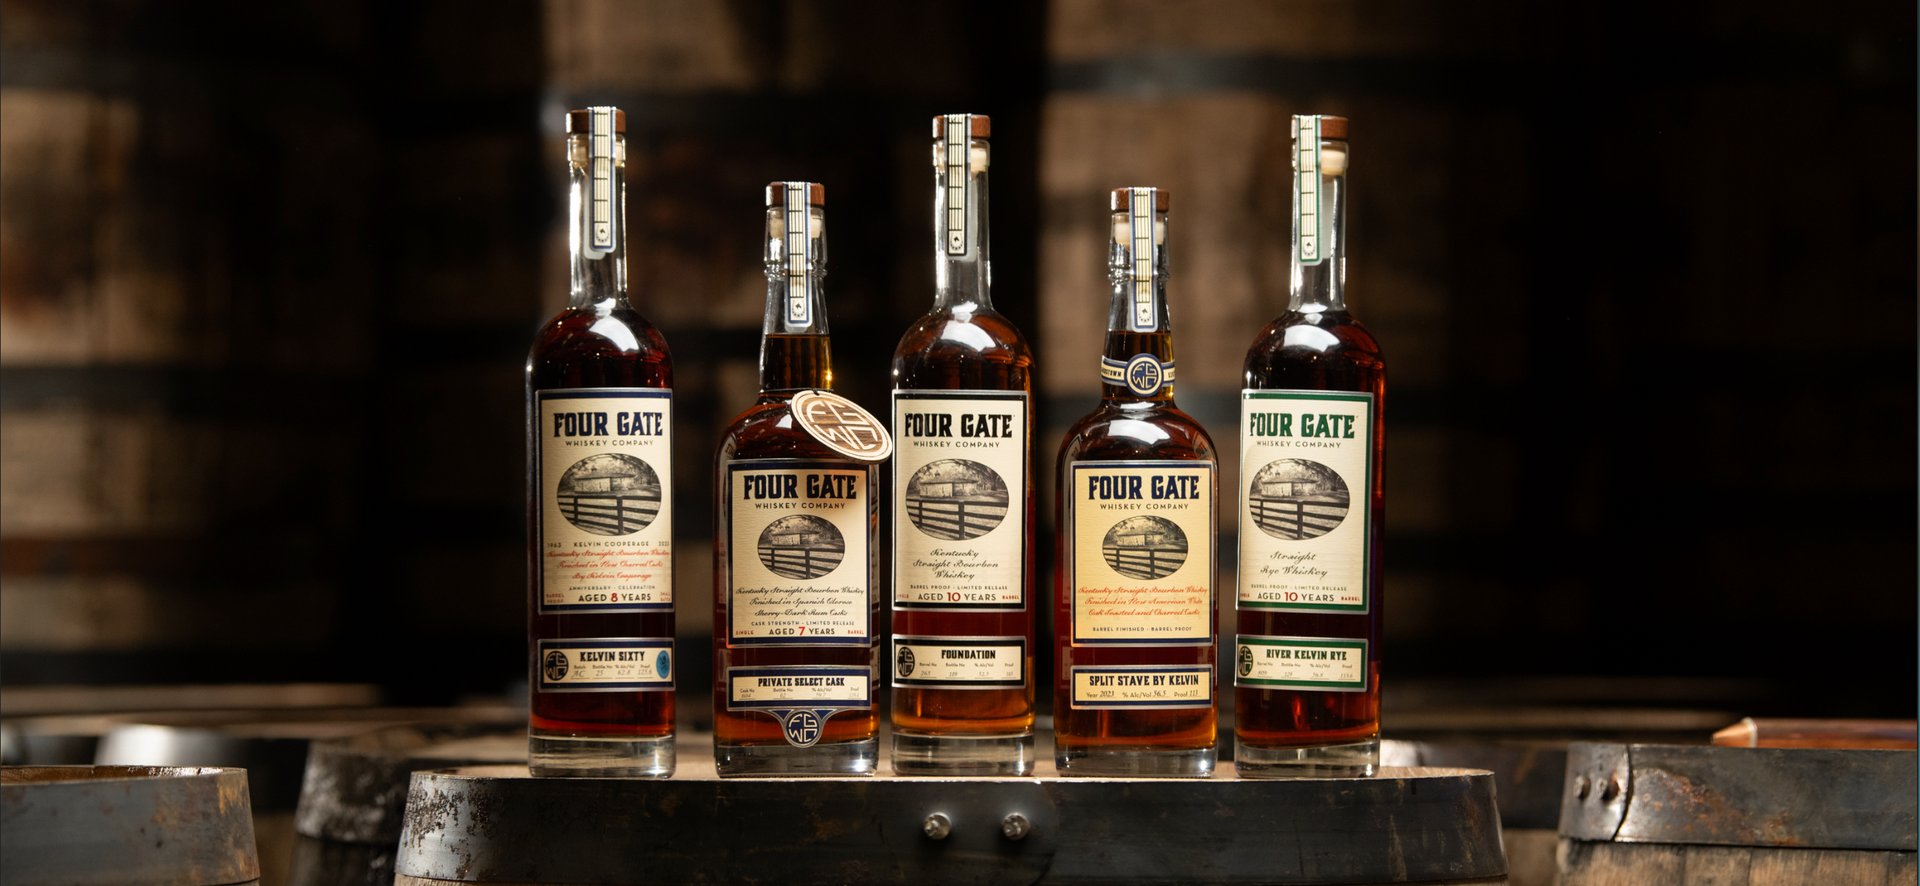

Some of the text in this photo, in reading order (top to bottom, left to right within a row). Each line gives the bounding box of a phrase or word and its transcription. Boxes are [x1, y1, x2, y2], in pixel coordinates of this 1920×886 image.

[553, 412, 663, 437] FOUR GATE
[904, 413, 1012, 438] FOUR GATE
[1250, 413, 1355, 438] FOUR GATE
[744, 474, 856, 500] FOUR GATE
[1088, 476, 1200, 500] FOUR GATE
[930, 548, 979, 560] Kentucky
[1270, 551, 1316, 564] Straight
[912, 560, 998, 571] Straight Bourbon
[934, 570, 975, 582] Whiskey
[1260, 565, 1328, 580] Rye Whiskey
[578, 594, 607, 602] AGED
[611, 592, 618, 602] 8
[736, 588, 770, 597] Kentucky
[770, 587, 803, 596] Straight
[946, 592, 961, 602] 10
[1114, 586, 1148, 597] Straight
[1284, 592, 1298, 602] 10
[793, 598, 824, 608] Spanish
[798, 626, 806, 635] 7
[580, 652, 645, 662] KELVIN SIXTY
[942, 650, 996, 659] FOUNDATION
[1266, 649, 1347, 660] RIVER KELVIN RYE
[758, 678, 845, 687] PRIVATE SELECT CASK
[1090, 675, 1199, 686] SPLIT STAVE BY KELVIN
